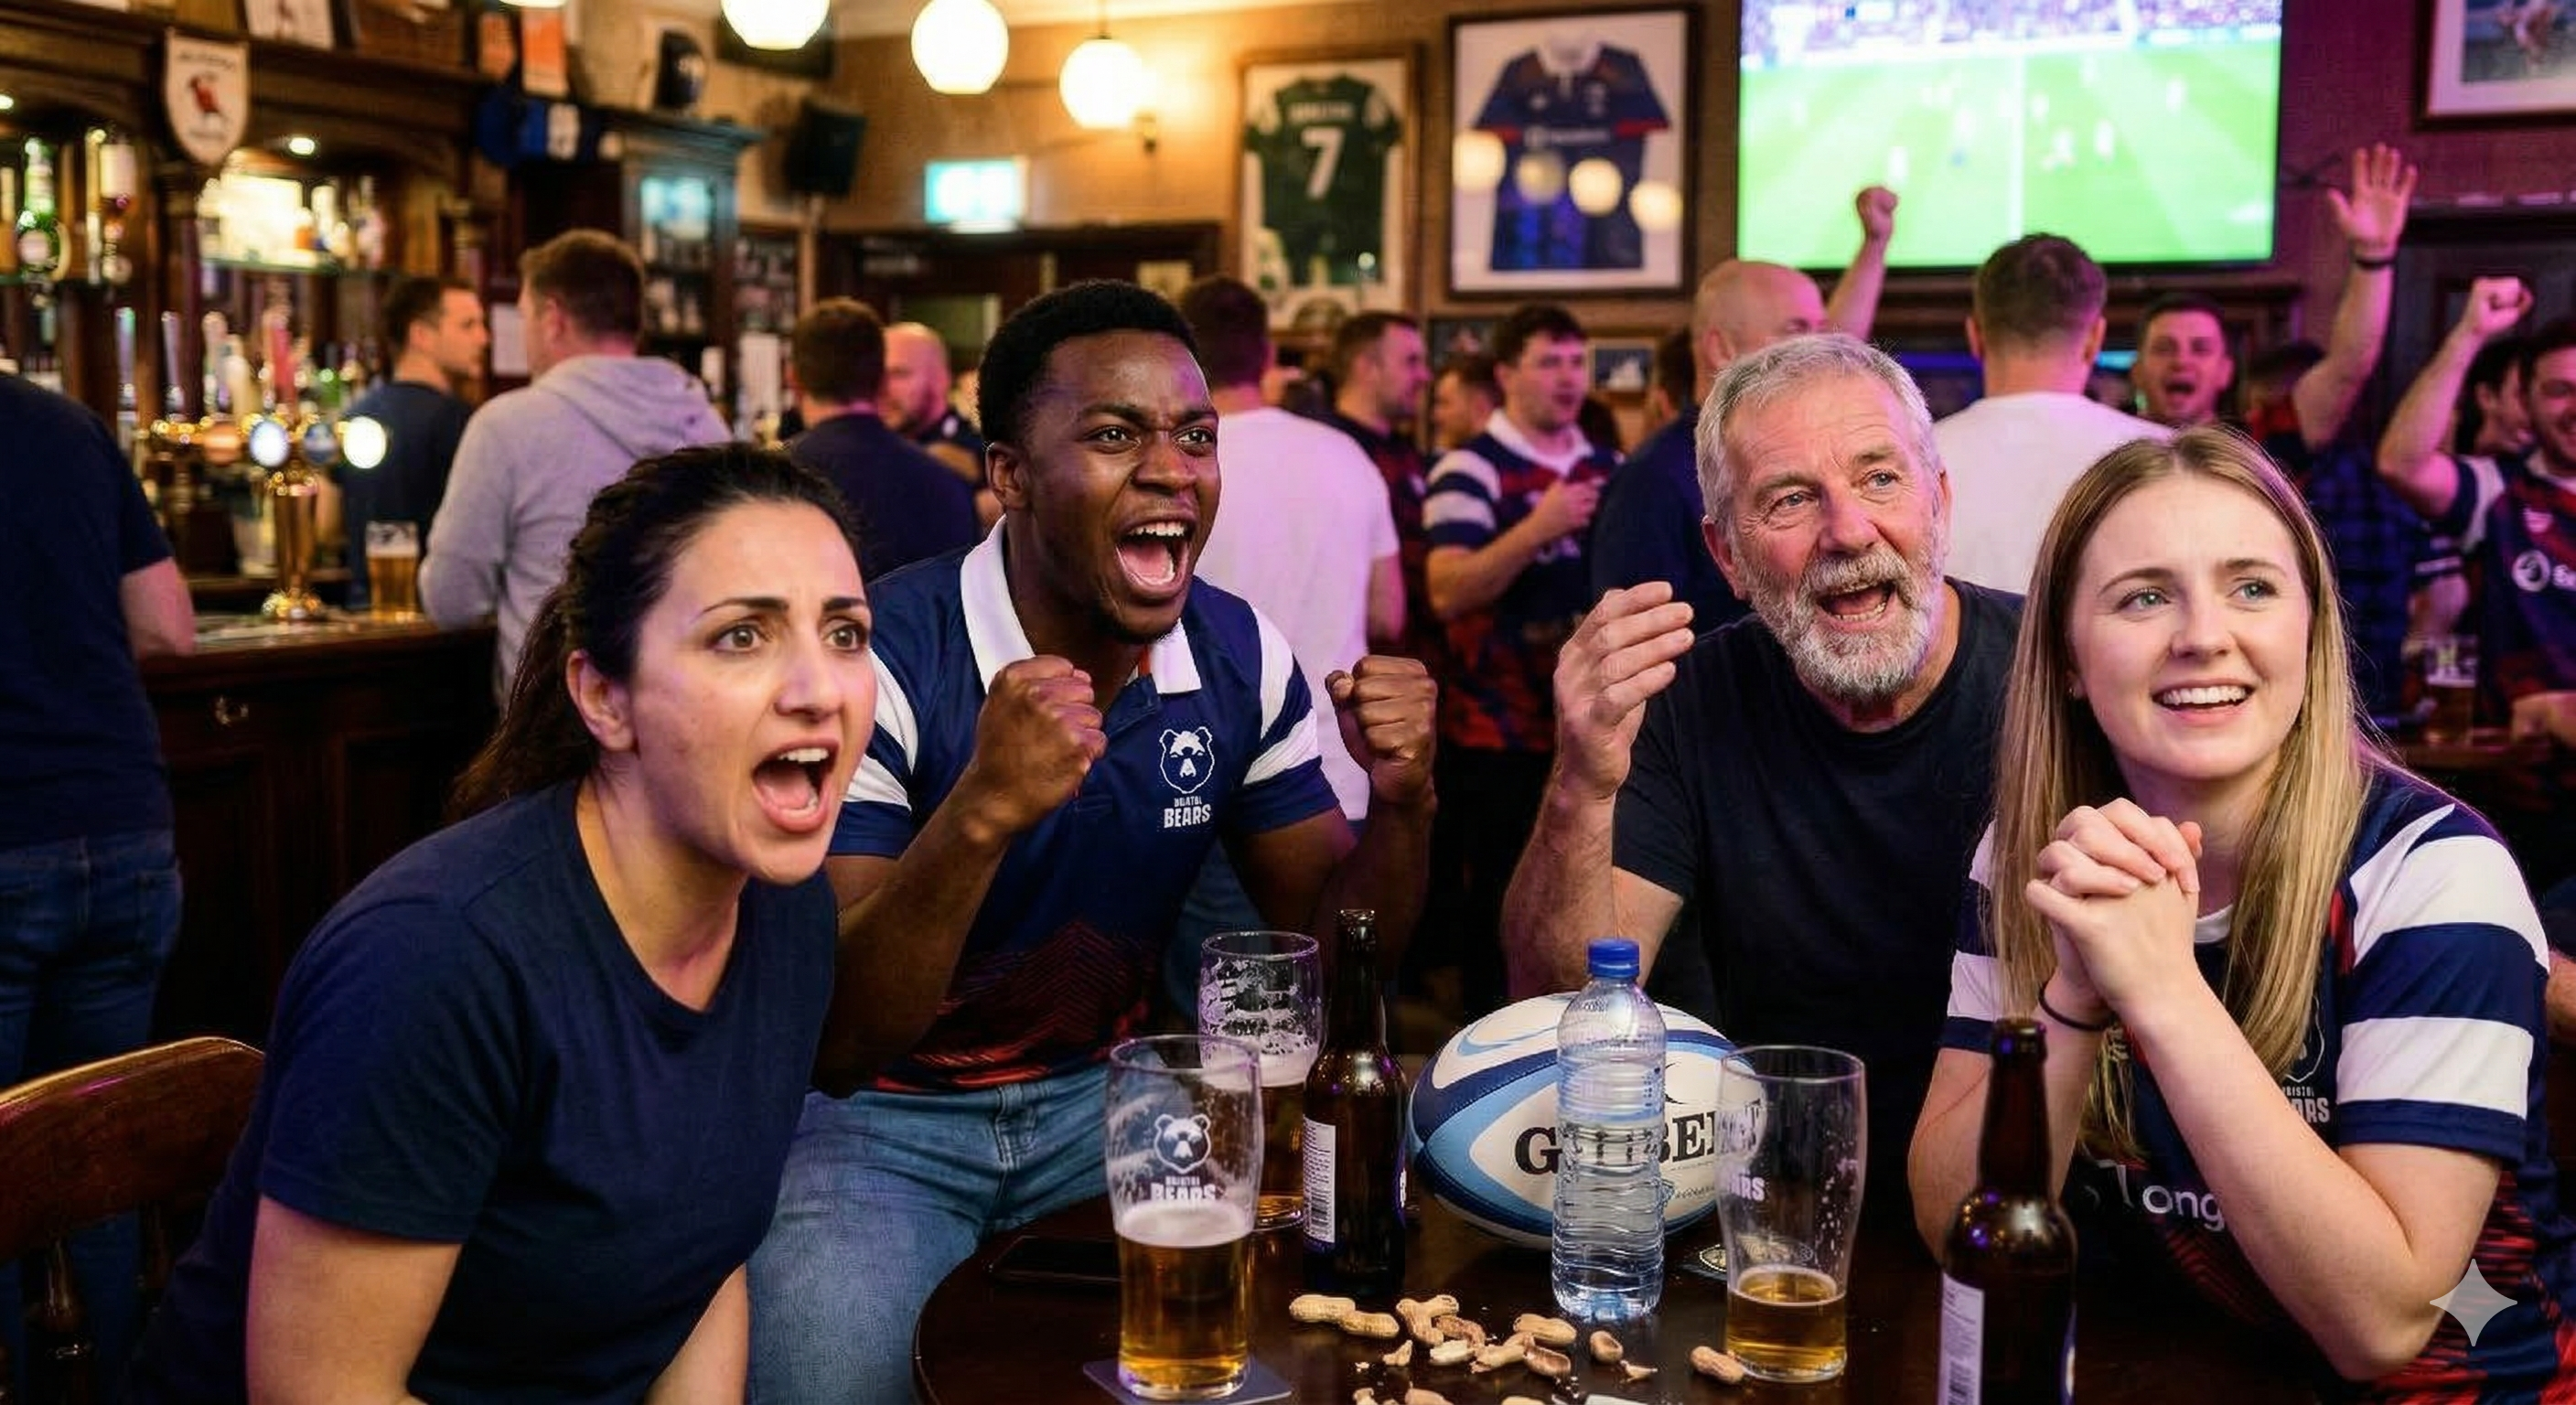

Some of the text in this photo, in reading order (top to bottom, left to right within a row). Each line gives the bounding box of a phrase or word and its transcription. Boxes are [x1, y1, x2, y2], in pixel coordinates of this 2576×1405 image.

[1301, 126, 1346, 200] 7
[1164, 804, 1212, 828] BEARS
[2291, 1097, 2331, 1124] ARS
[1730, 1175, 1766, 1202] ARS
